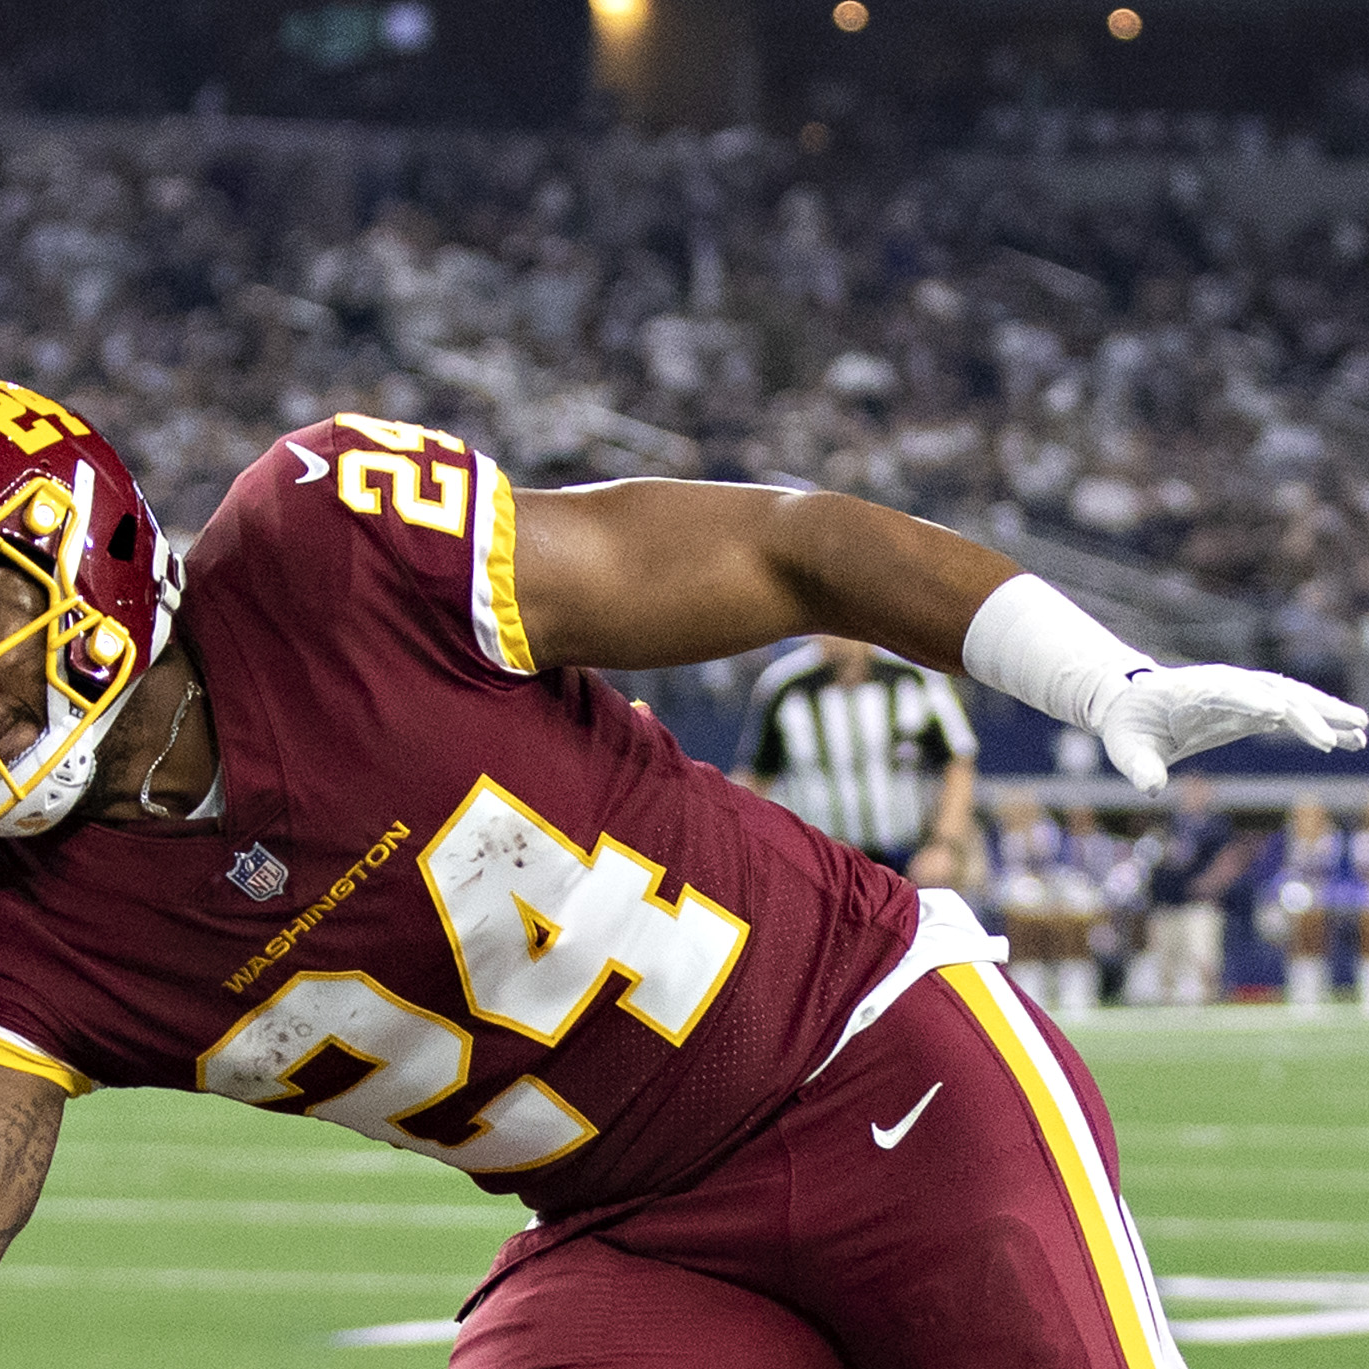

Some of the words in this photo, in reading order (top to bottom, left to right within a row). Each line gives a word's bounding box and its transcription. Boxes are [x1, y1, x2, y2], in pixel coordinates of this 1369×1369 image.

[334, 411, 469, 539] 24
[221, 819, 411, 994] WASHINGTON
[246, 865, 281, 897] NFL
[195, 773, 751, 1173] 24
